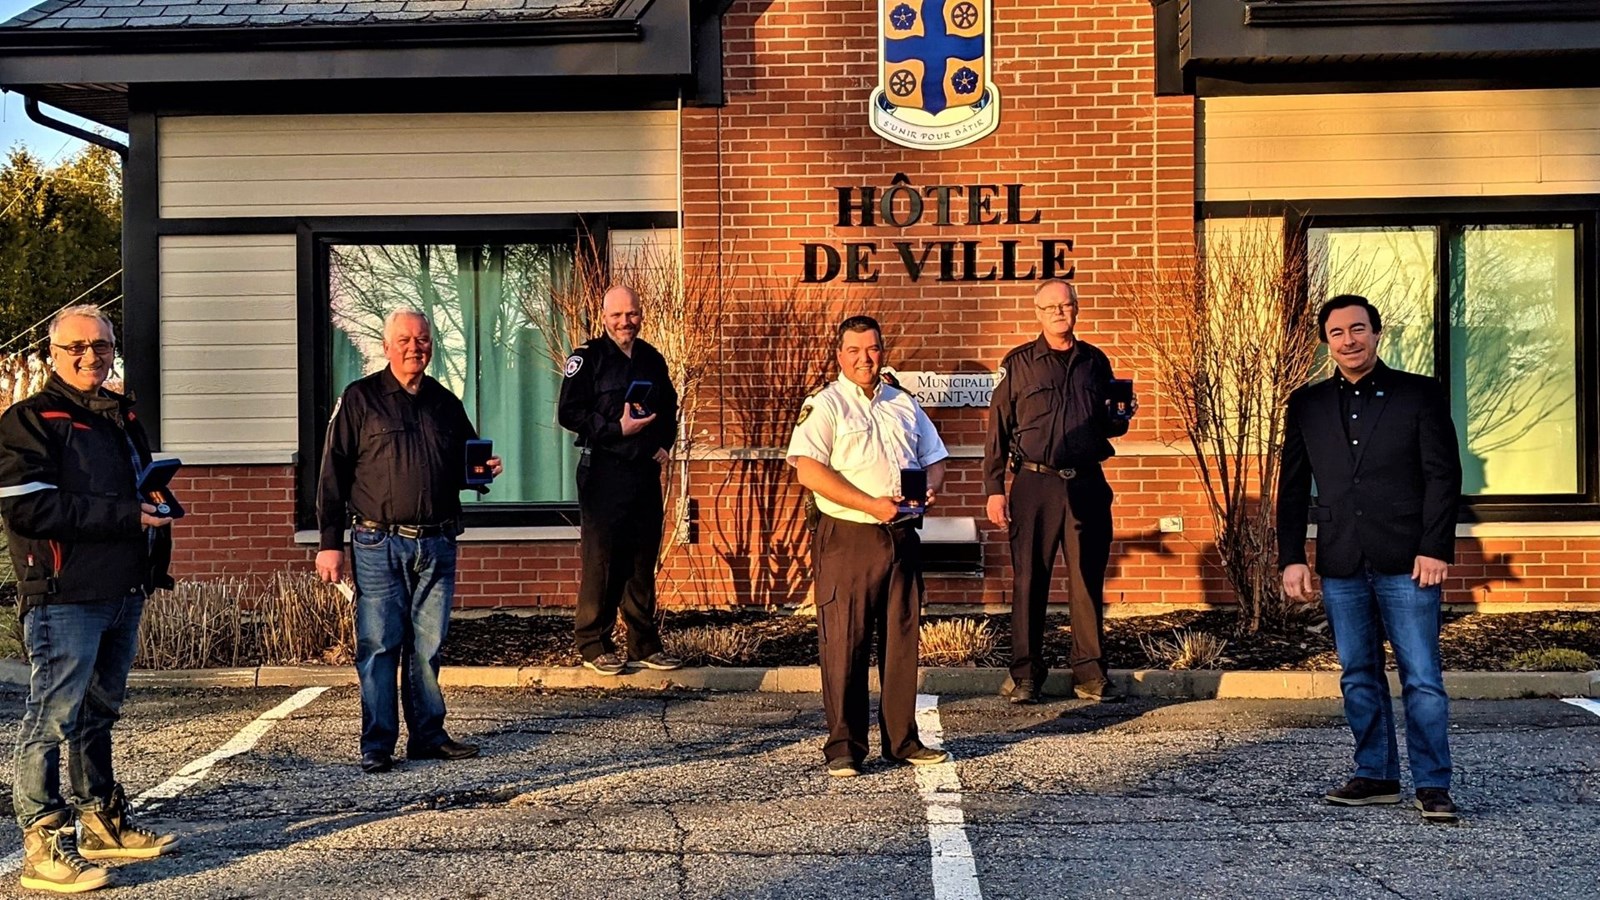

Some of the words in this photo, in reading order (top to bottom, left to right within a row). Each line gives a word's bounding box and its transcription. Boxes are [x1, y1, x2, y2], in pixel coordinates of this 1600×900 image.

[883, 120, 918, 139] S'UNIR
[921, 131, 951, 141] POUR
[955, 118, 984, 136] BÂTIR
[834, 172, 1042, 228] HÔTEL
[800, 242, 880, 283] DE
[893, 239, 1076, 283] VILLE
